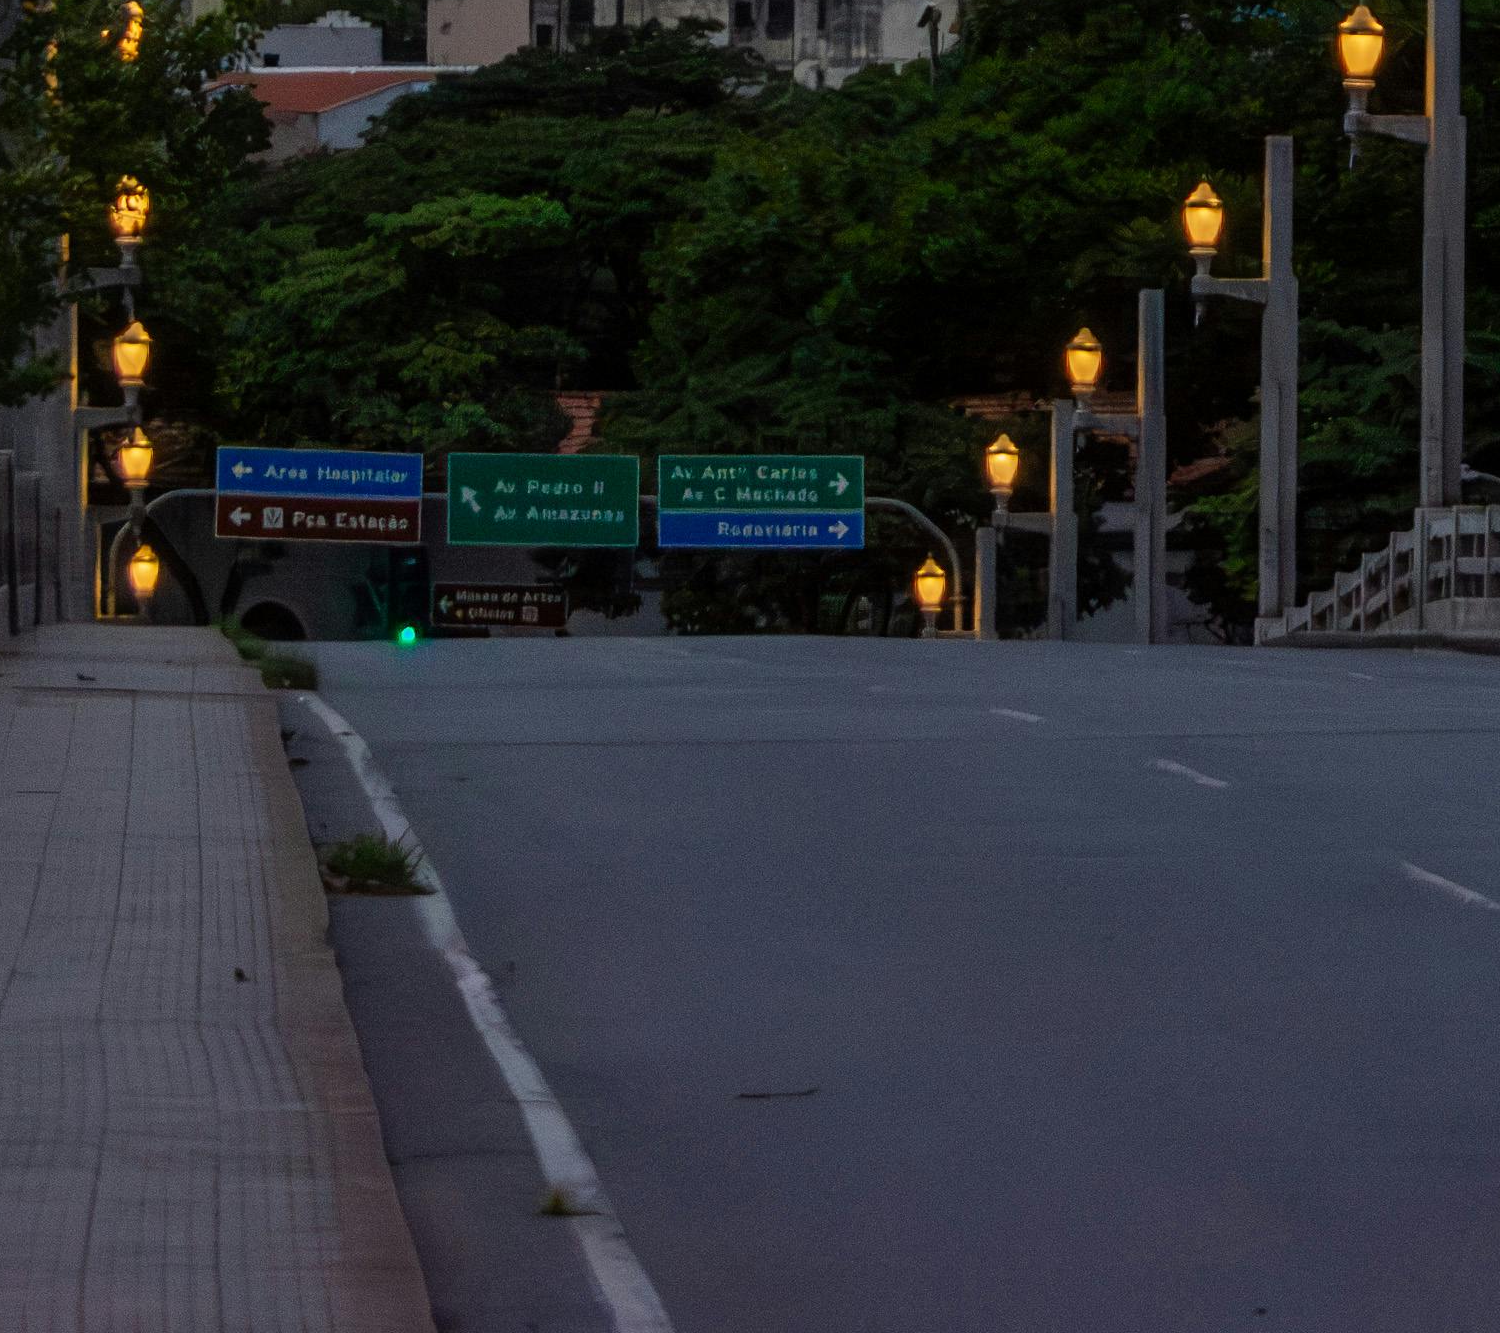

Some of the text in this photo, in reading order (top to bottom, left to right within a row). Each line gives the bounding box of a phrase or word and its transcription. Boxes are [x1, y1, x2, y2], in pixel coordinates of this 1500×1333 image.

[317, 465, 408, 485] Hospitalar
[756, 465, 818, 481] Carlos
[527, 479, 585, 495] Pedro
[593, 480, 605, 495] II
[736, 486, 818, 502] Machado
[335, 511, 409, 532] Estação
[527, 506, 625, 522] Amazonas
